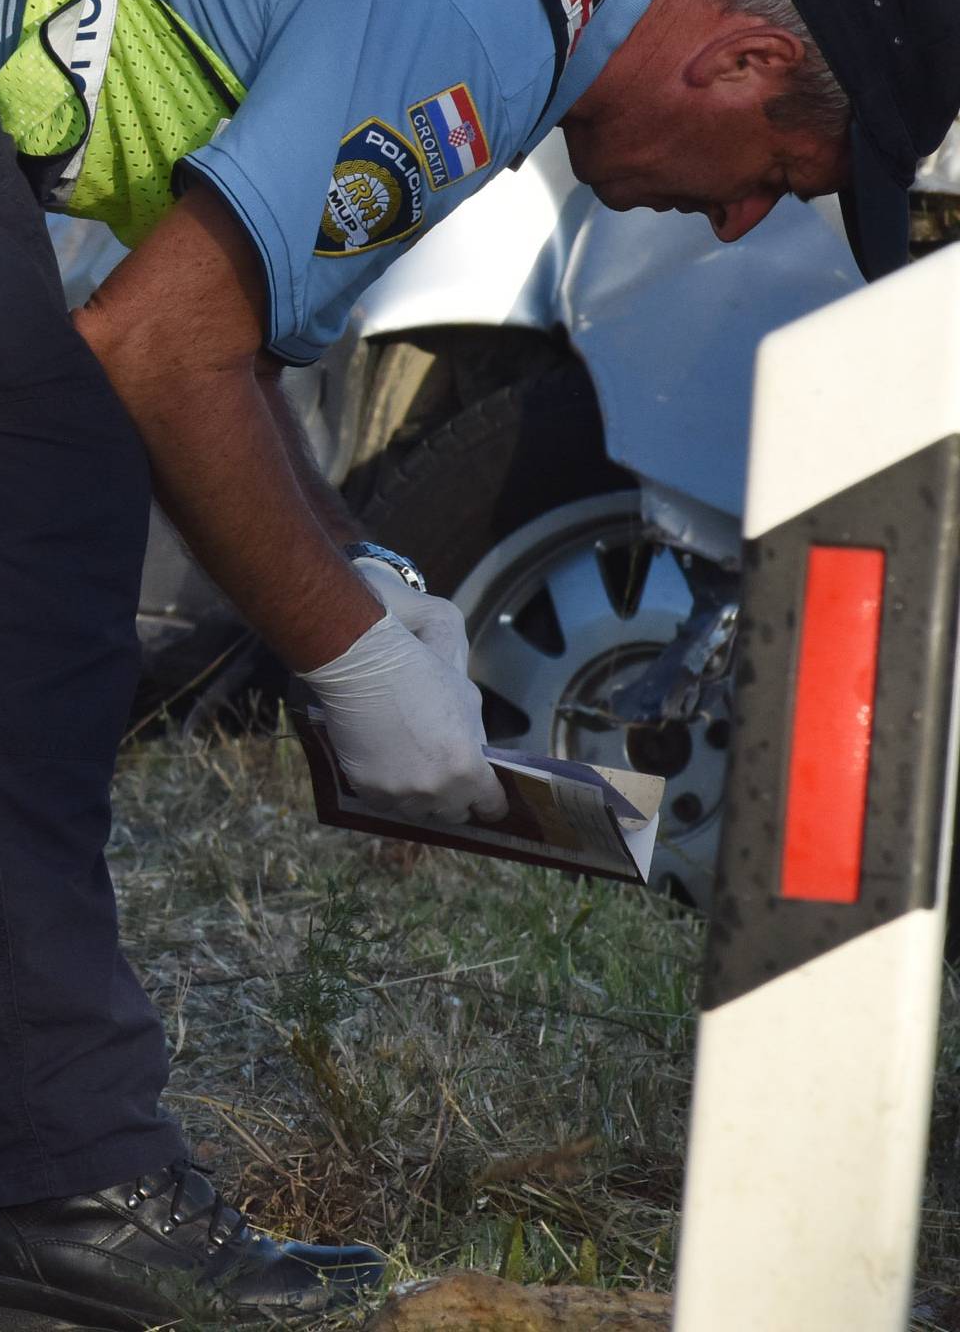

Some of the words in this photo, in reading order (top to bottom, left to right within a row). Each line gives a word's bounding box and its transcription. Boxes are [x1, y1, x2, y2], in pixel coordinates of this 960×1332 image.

[365, 129, 423, 224] POLICIJA
[413, 113, 446, 185] CROATIA
[328, 188, 358, 232] MUP
